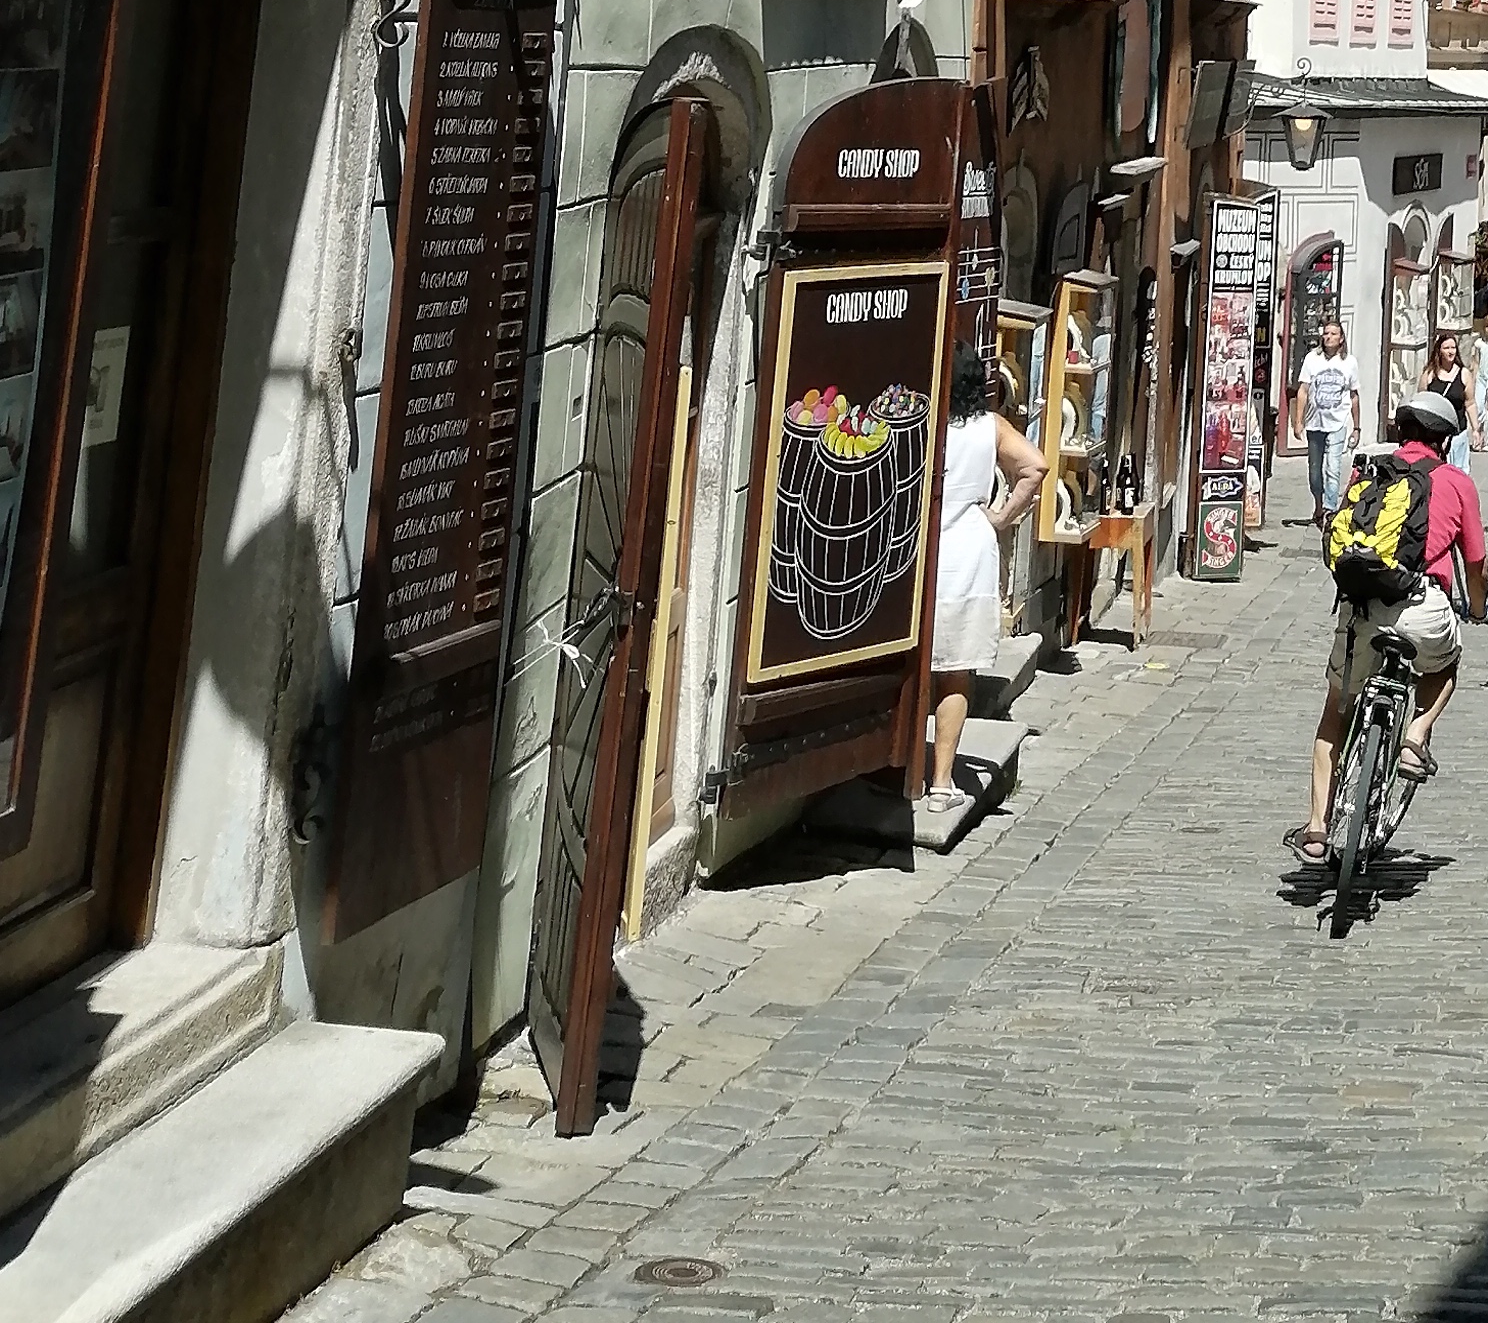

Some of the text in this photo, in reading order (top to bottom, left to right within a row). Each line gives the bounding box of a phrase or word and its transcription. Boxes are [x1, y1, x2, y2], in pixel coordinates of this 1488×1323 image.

[838, 148, 920, 179] CANDY SHOP
[1217, 209, 1257, 233] MUZEUM
[1229, 253, 1254, 269] ČESKÝ
[1214, 269, 1253, 285] KRUMLOV
[826, 289, 909, 324] CANDY SHOP
